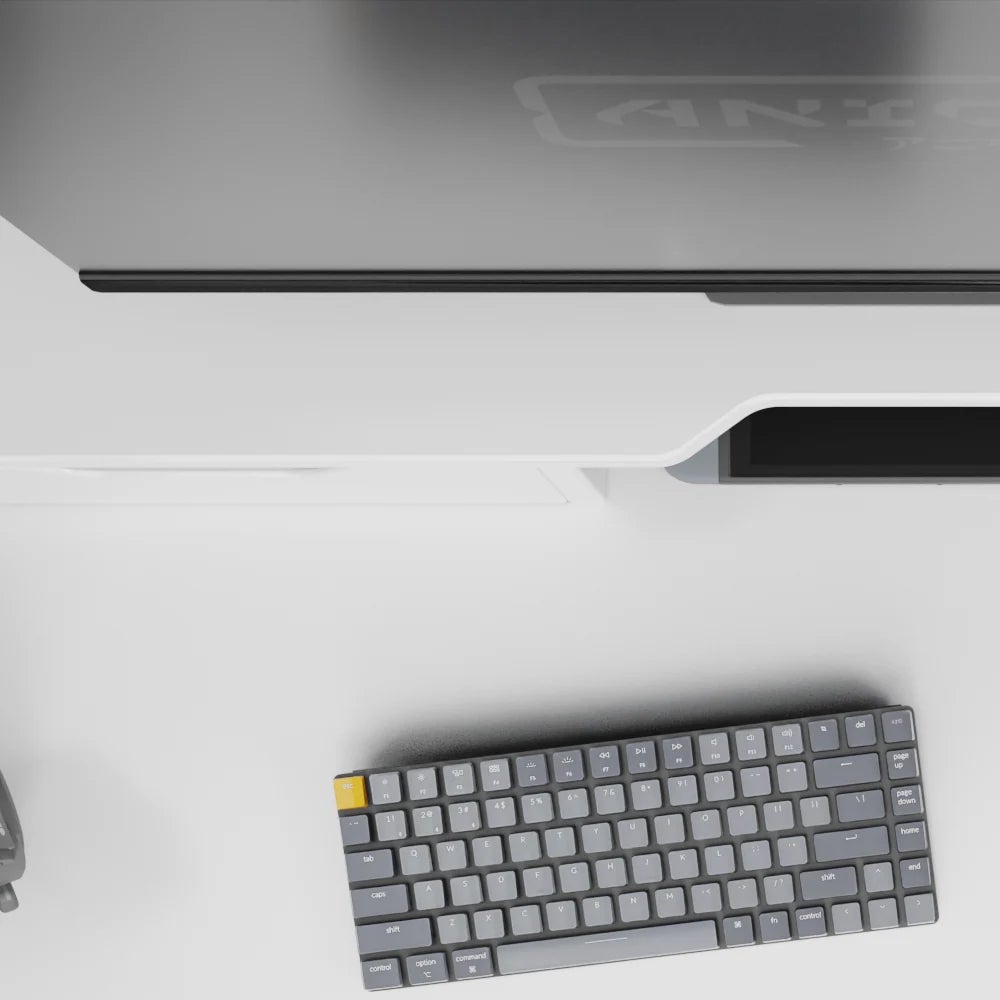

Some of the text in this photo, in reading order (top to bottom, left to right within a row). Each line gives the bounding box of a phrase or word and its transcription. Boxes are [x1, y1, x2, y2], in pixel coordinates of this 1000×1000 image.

[898, 797, 916, 805] down
[901, 826, 920, 835] home
[908, 863, 921, 871] end
[821, 873, 836, 881] shift
[370, 891, 386, 899] caps
[799, 912, 822, 920] control
[386, 926, 400, 934] shift
[455, 952, 487, 962] command
[415, 959, 437, 968] option
[369, 964, 392, 973] control
